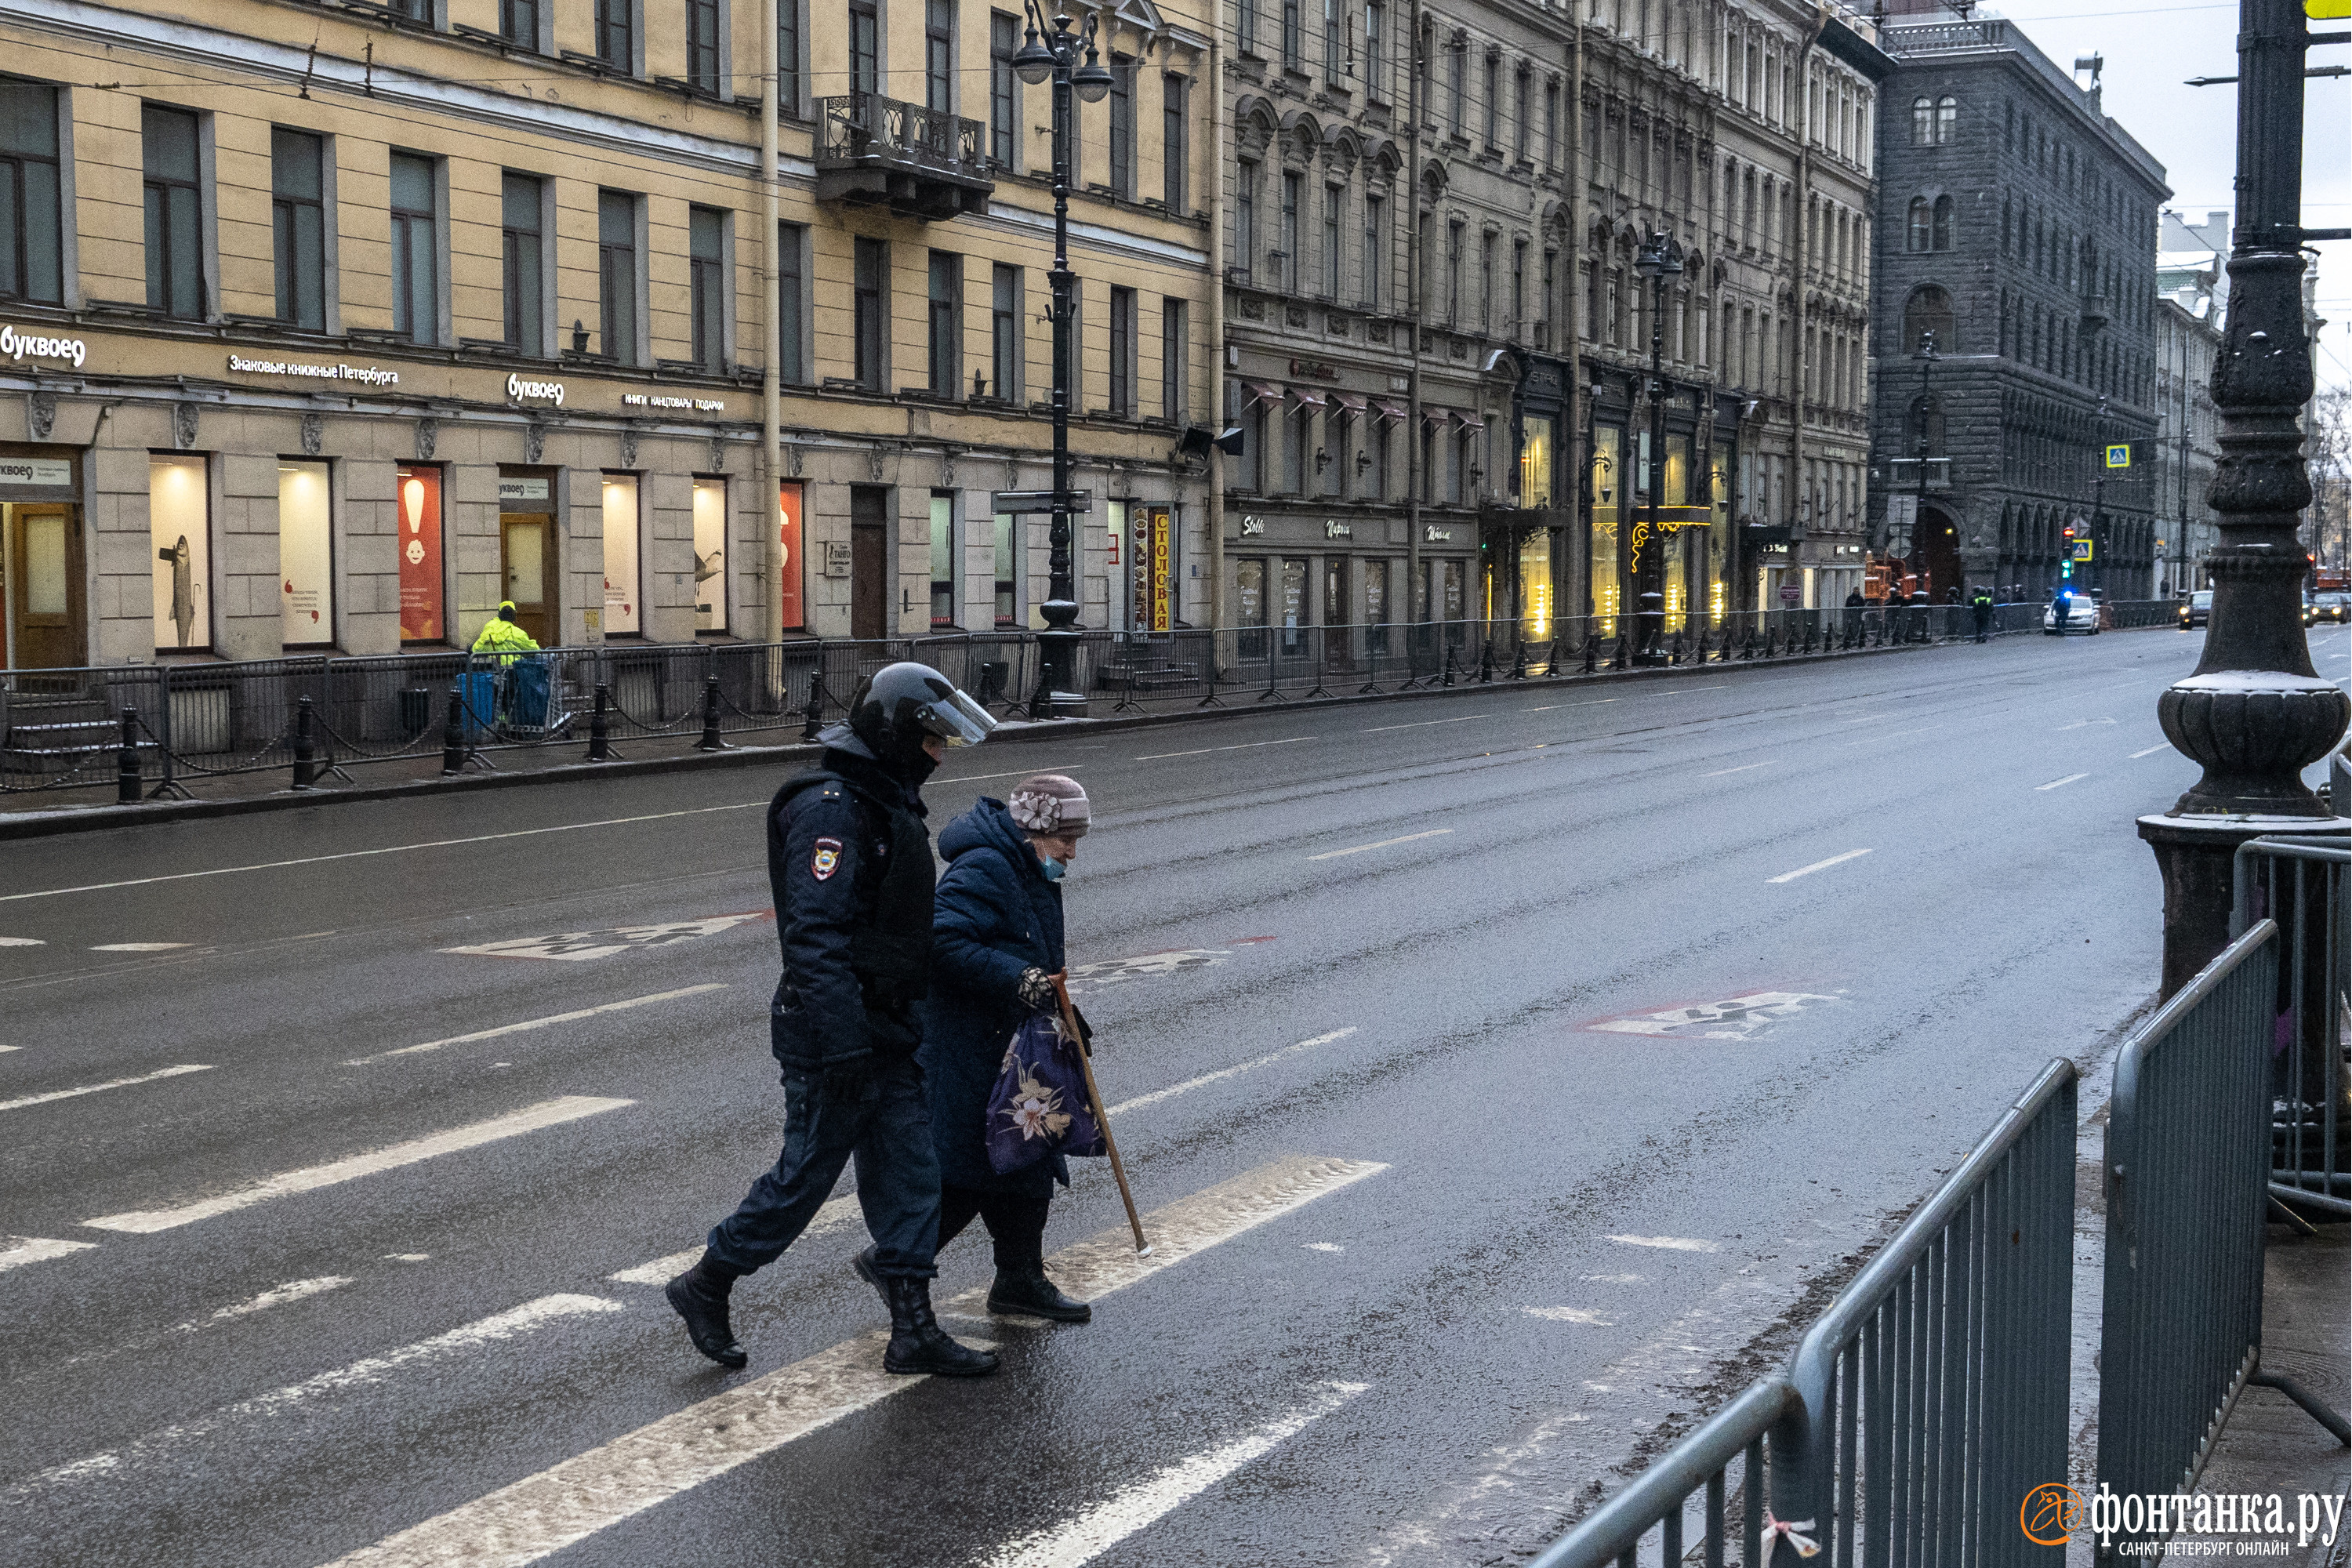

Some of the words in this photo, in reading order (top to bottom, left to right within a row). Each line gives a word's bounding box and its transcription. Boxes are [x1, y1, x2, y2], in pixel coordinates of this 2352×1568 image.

[1, 325, 85, 367] буквоед
[230, 355, 285, 374] Знаковые
[287, 363, 337, 378] книжные
[339, 364, 398, 385] Петербурга
[508, 373, 564, 406] буквоед
[625, 394, 647, 405] КНИГИ
[651, 396, 692, 408] КАНЦТОВАРЫ
[695, 398, 724, 412] ПОДАРКИ
[0, 465, 33, 480] квоед
